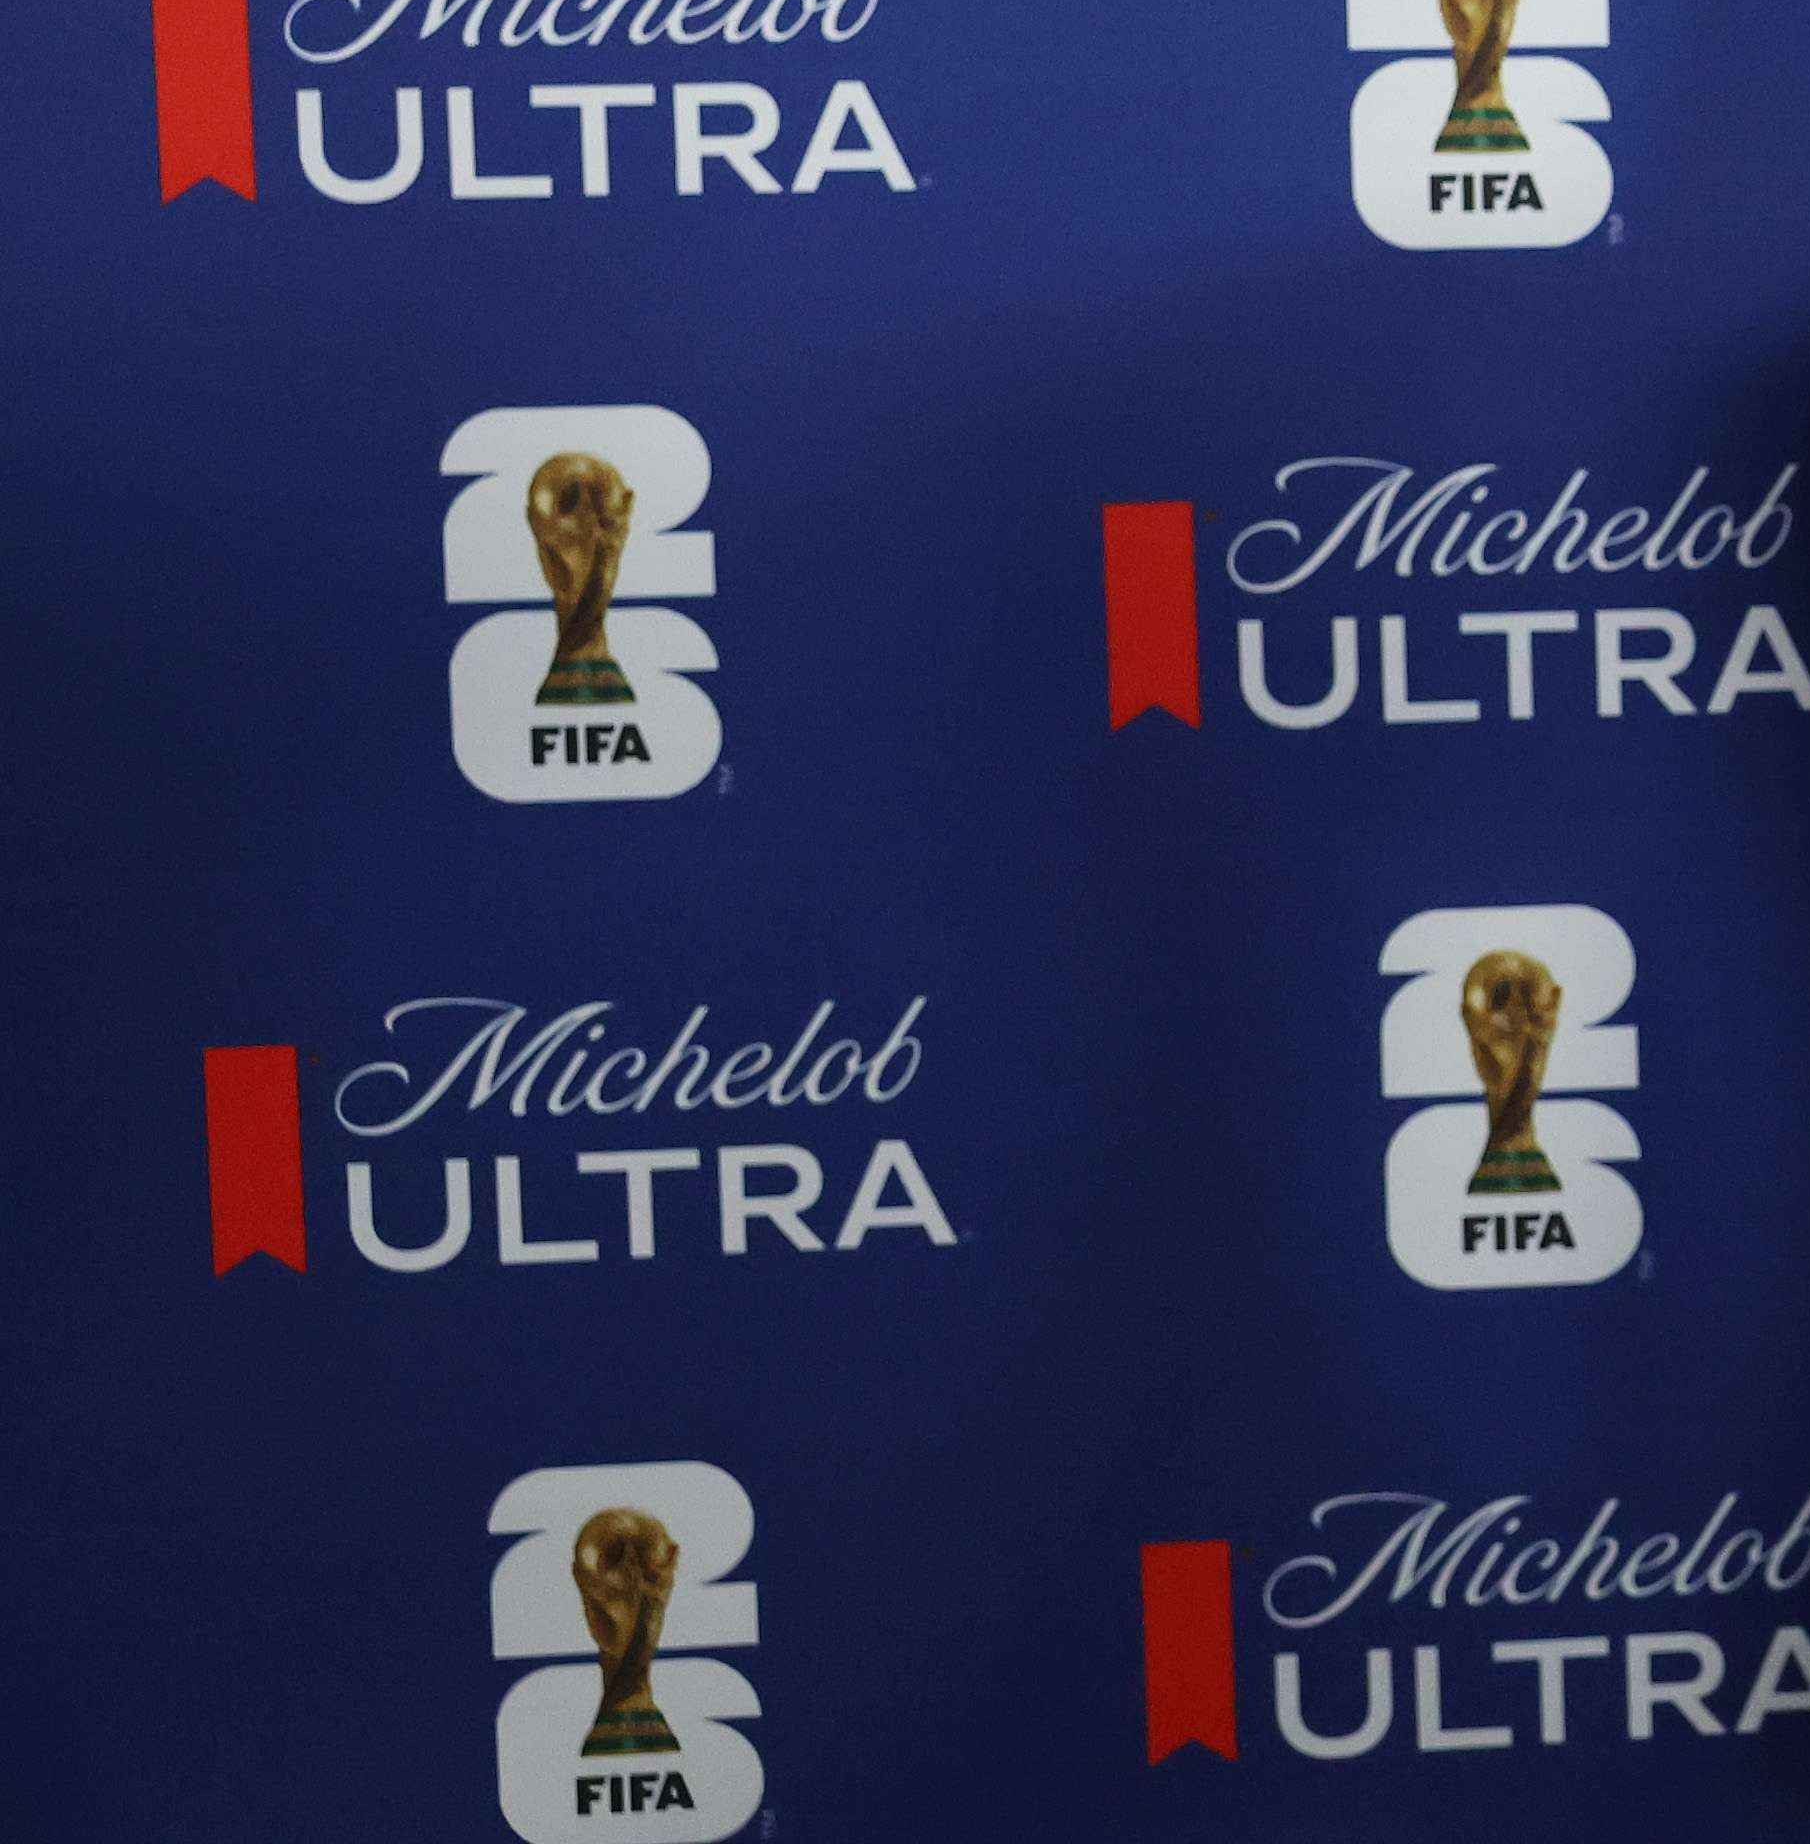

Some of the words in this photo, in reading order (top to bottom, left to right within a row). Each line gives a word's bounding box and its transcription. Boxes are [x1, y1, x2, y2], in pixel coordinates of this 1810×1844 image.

[296, 81, 916, 204] ULTRA
[1430, 174, 1543, 212] FIFA
[1226, 456, 1796, 595] Michelob
[531, 724, 650, 765] FIFA
[335, 996, 926, 1137] Michelob
[347, 1140, 957, 1272] ULTRA
[1463, 1213, 1575, 1253] FIFA
[576, 1772, 694, 1815] FIFA
